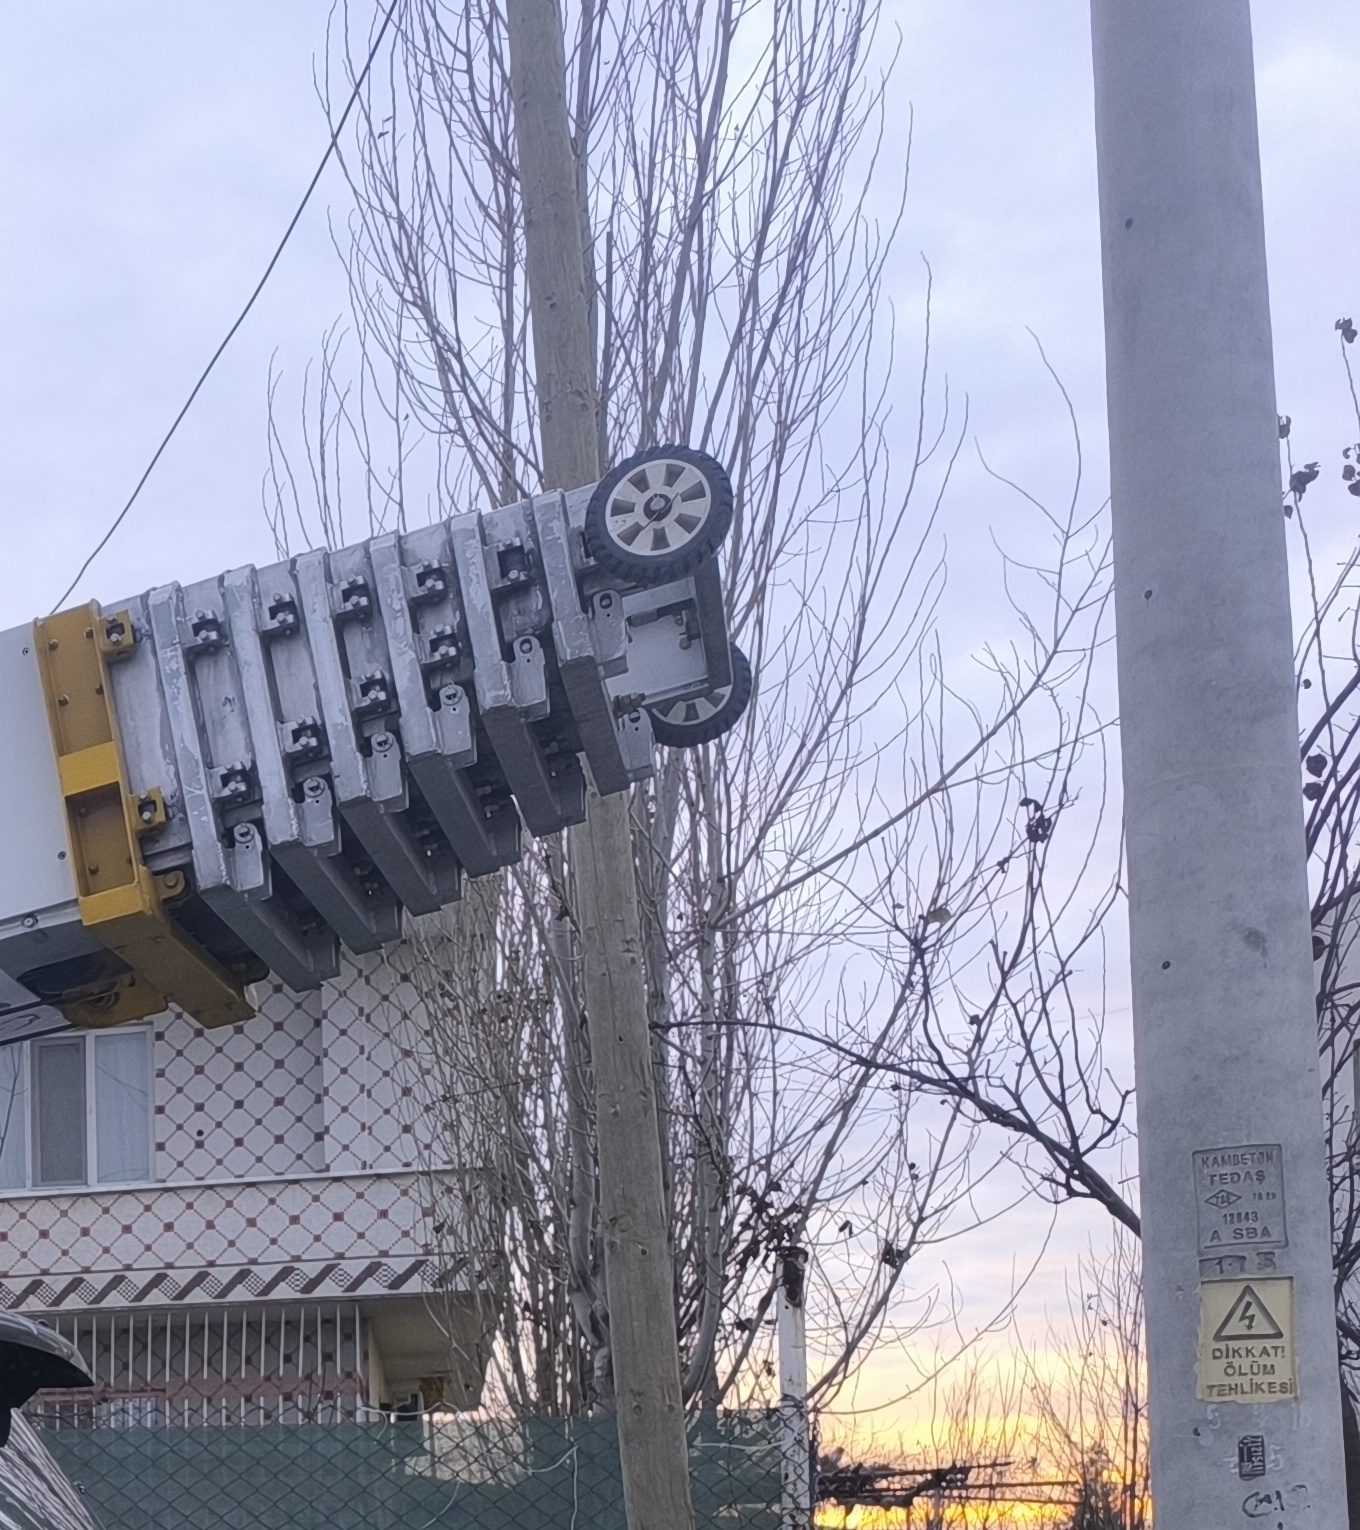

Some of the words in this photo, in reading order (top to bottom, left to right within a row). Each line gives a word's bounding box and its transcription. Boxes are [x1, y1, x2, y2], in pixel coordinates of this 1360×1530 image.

[1208, 1169, 1266, 1186] TEDAŞ
[1210, 1230, 1222, 1243] A
[1232, 1226, 1272, 1240] SBA
[1212, 1343, 1286, 1360] DİKKAT!
[1223, 1360, 1275, 1377] ÖLÜM
[1206, 1378, 1294, 1398] TEHLİKESİ
